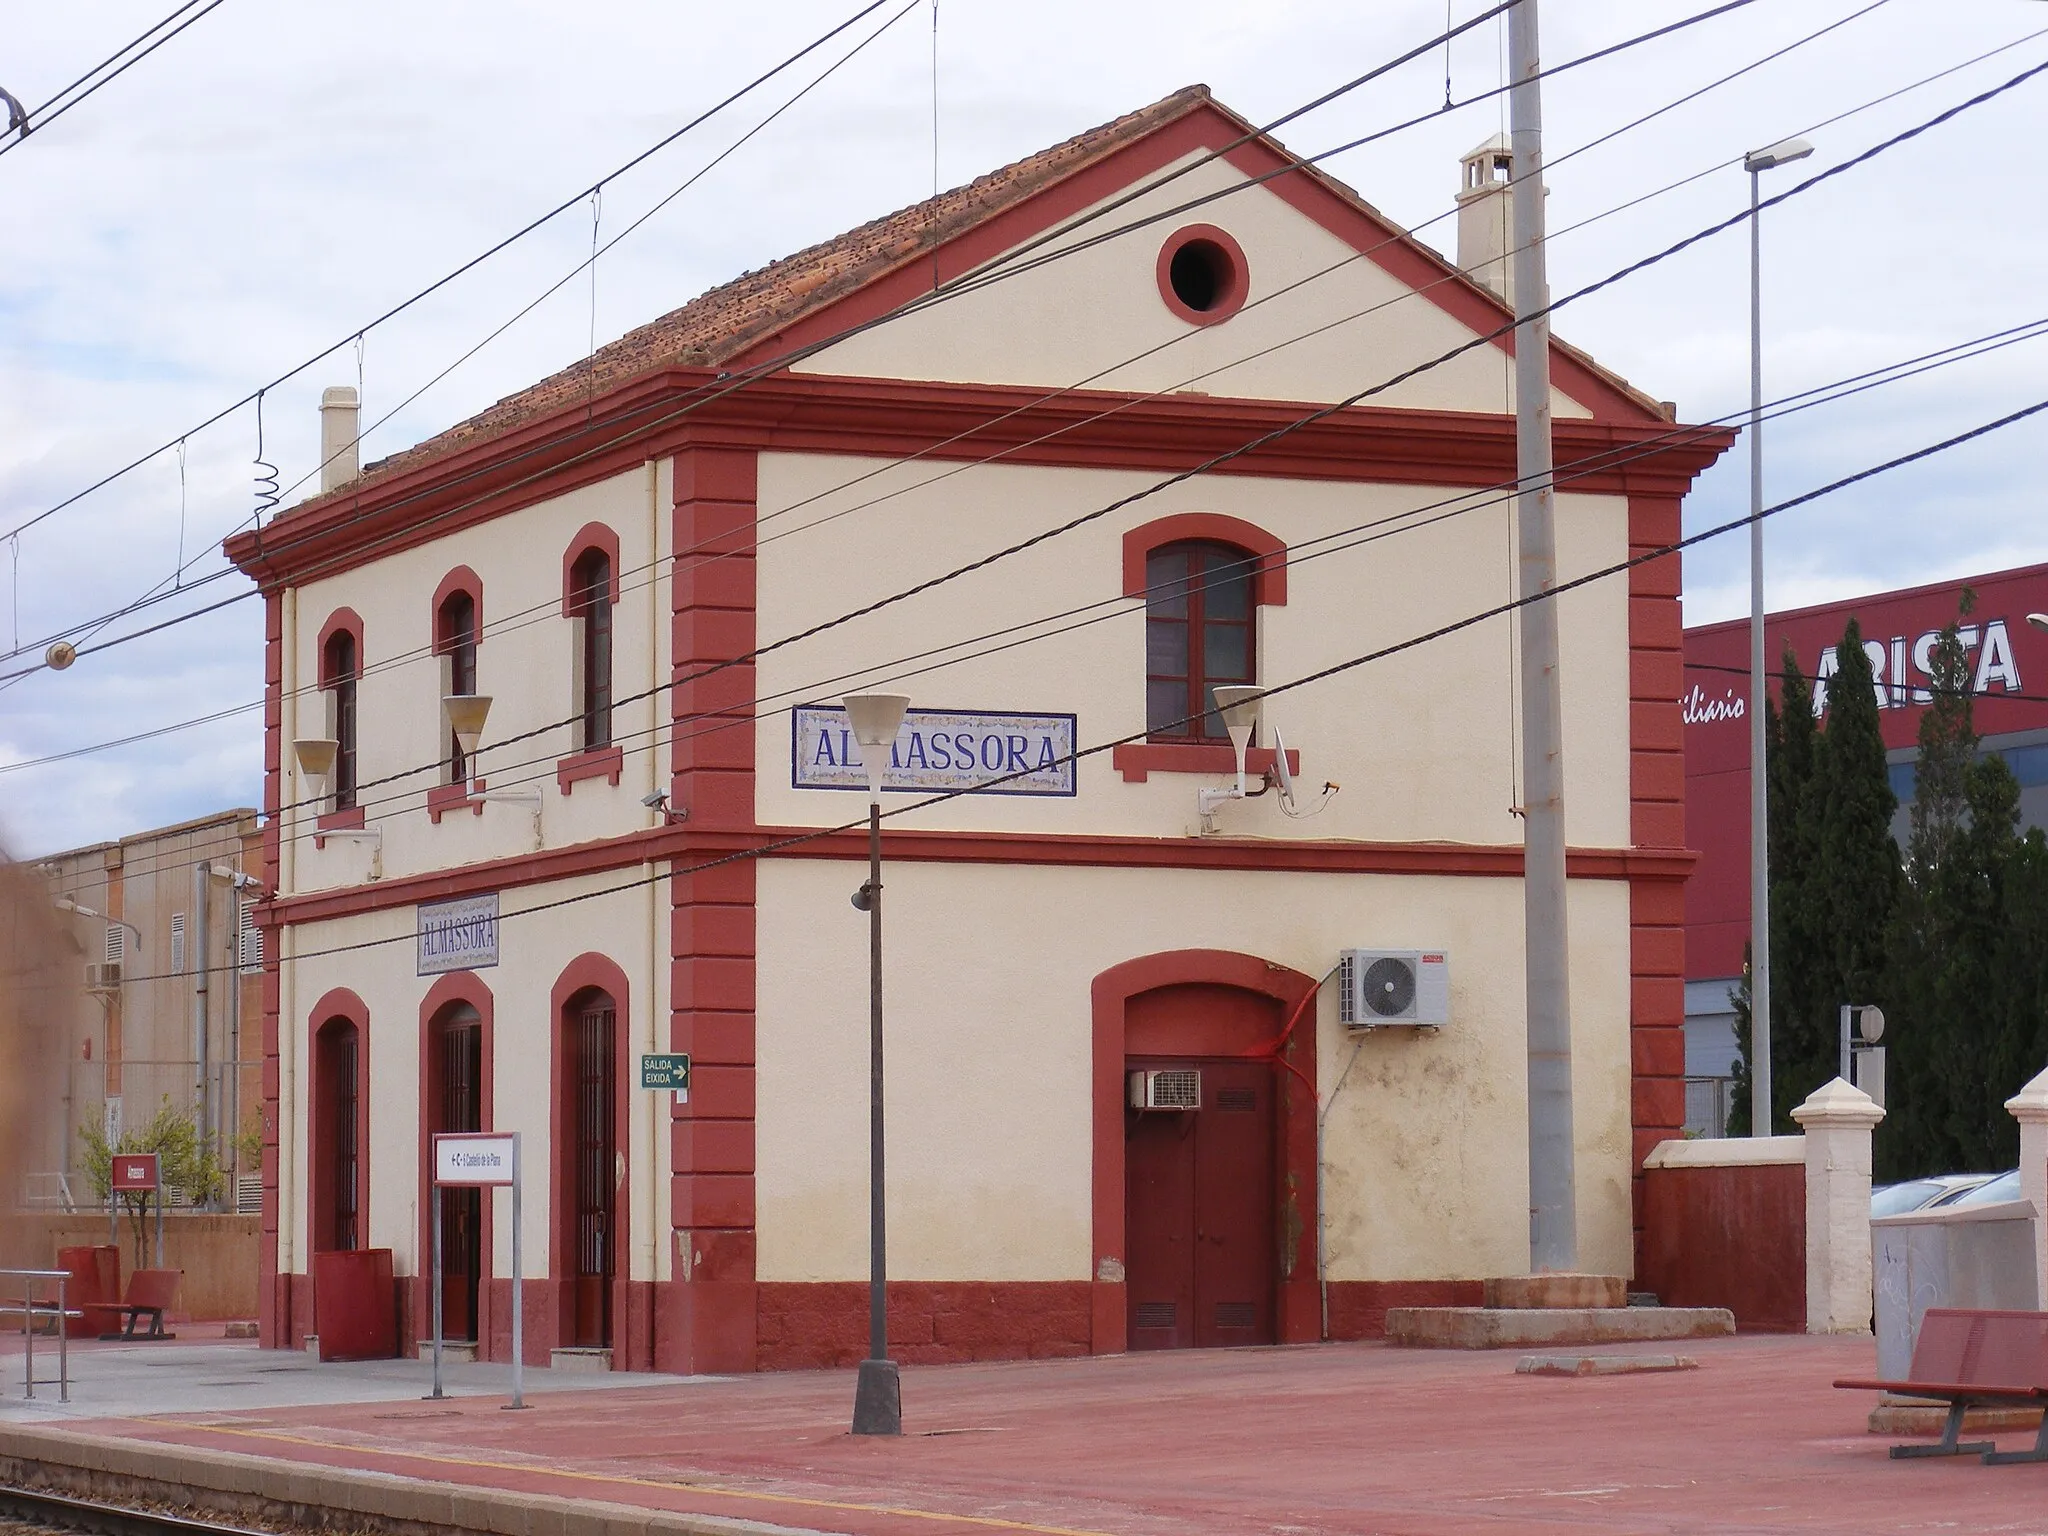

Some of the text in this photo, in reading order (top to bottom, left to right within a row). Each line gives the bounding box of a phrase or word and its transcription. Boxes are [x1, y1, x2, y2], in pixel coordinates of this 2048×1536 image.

[1678, 685, 1745, 724] iliario
[423, 913, 494, 956] ALMASSORA
[644, 1060, 672, 1070] SALIDA
[646, 1073, 671, 1083] EIXIDA
